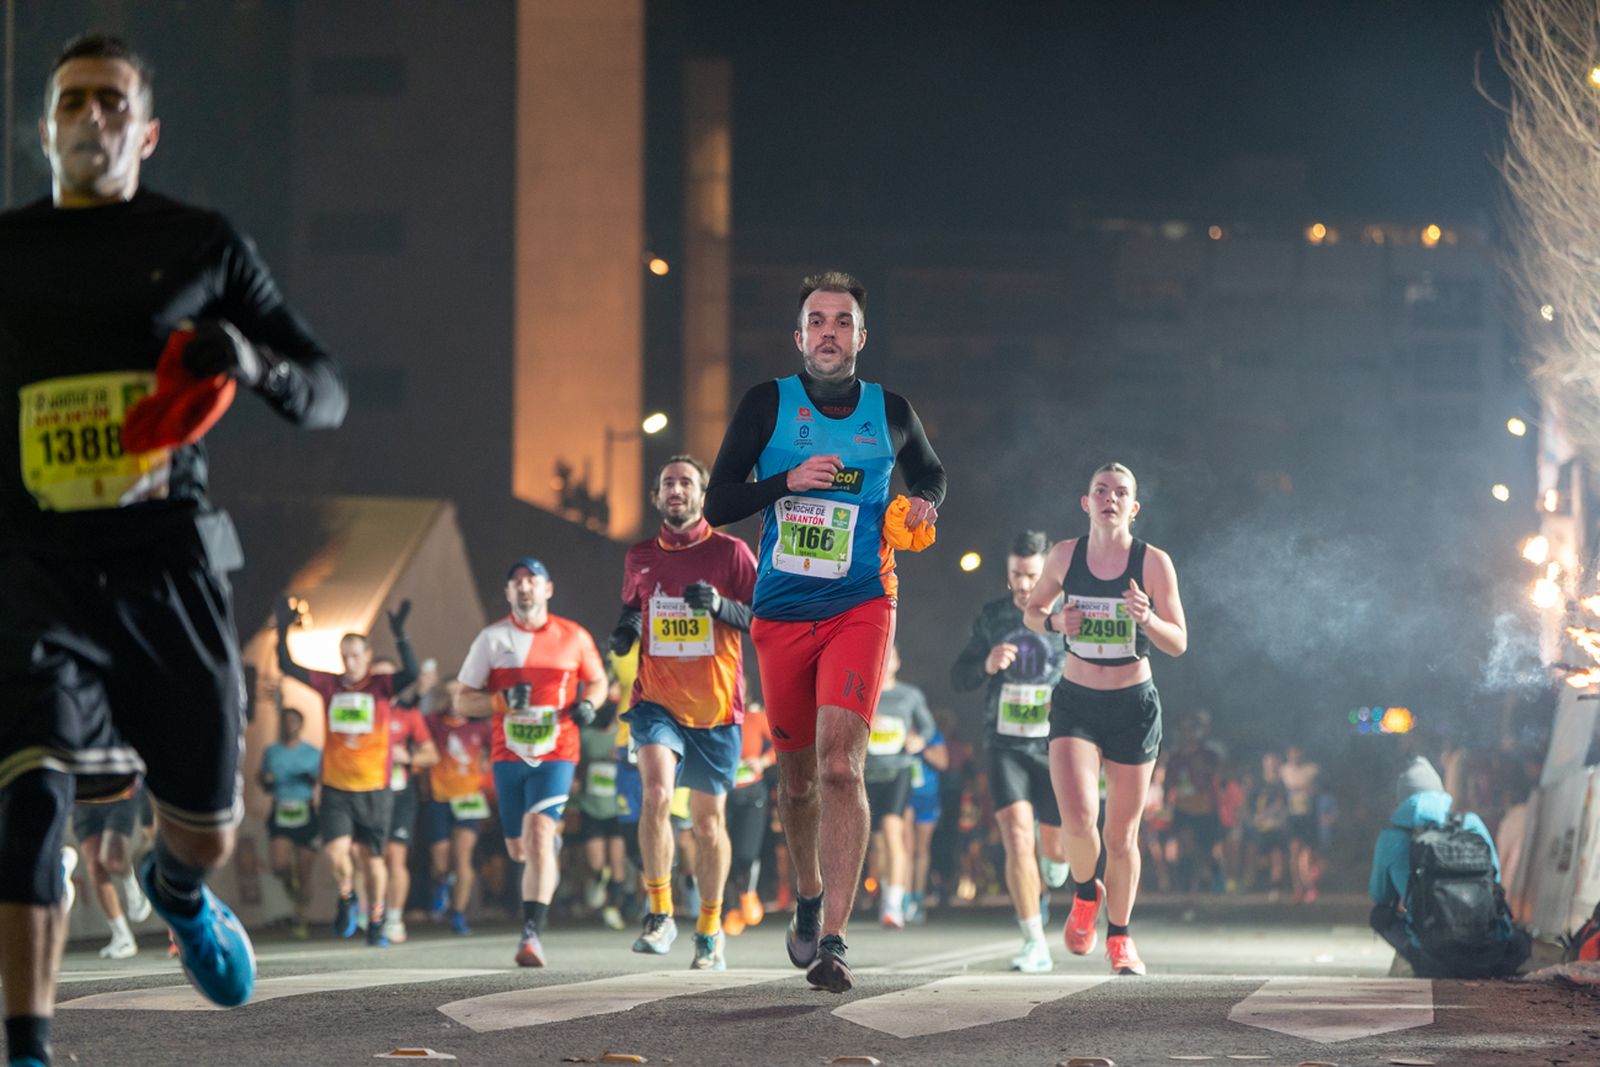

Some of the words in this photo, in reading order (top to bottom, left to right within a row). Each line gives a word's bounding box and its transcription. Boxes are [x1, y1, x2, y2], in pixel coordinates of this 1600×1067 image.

[833, 471, 858, 484] col
[662, 619, 699, 636] 3103
[1079, 619, 1127, 637] 2490
